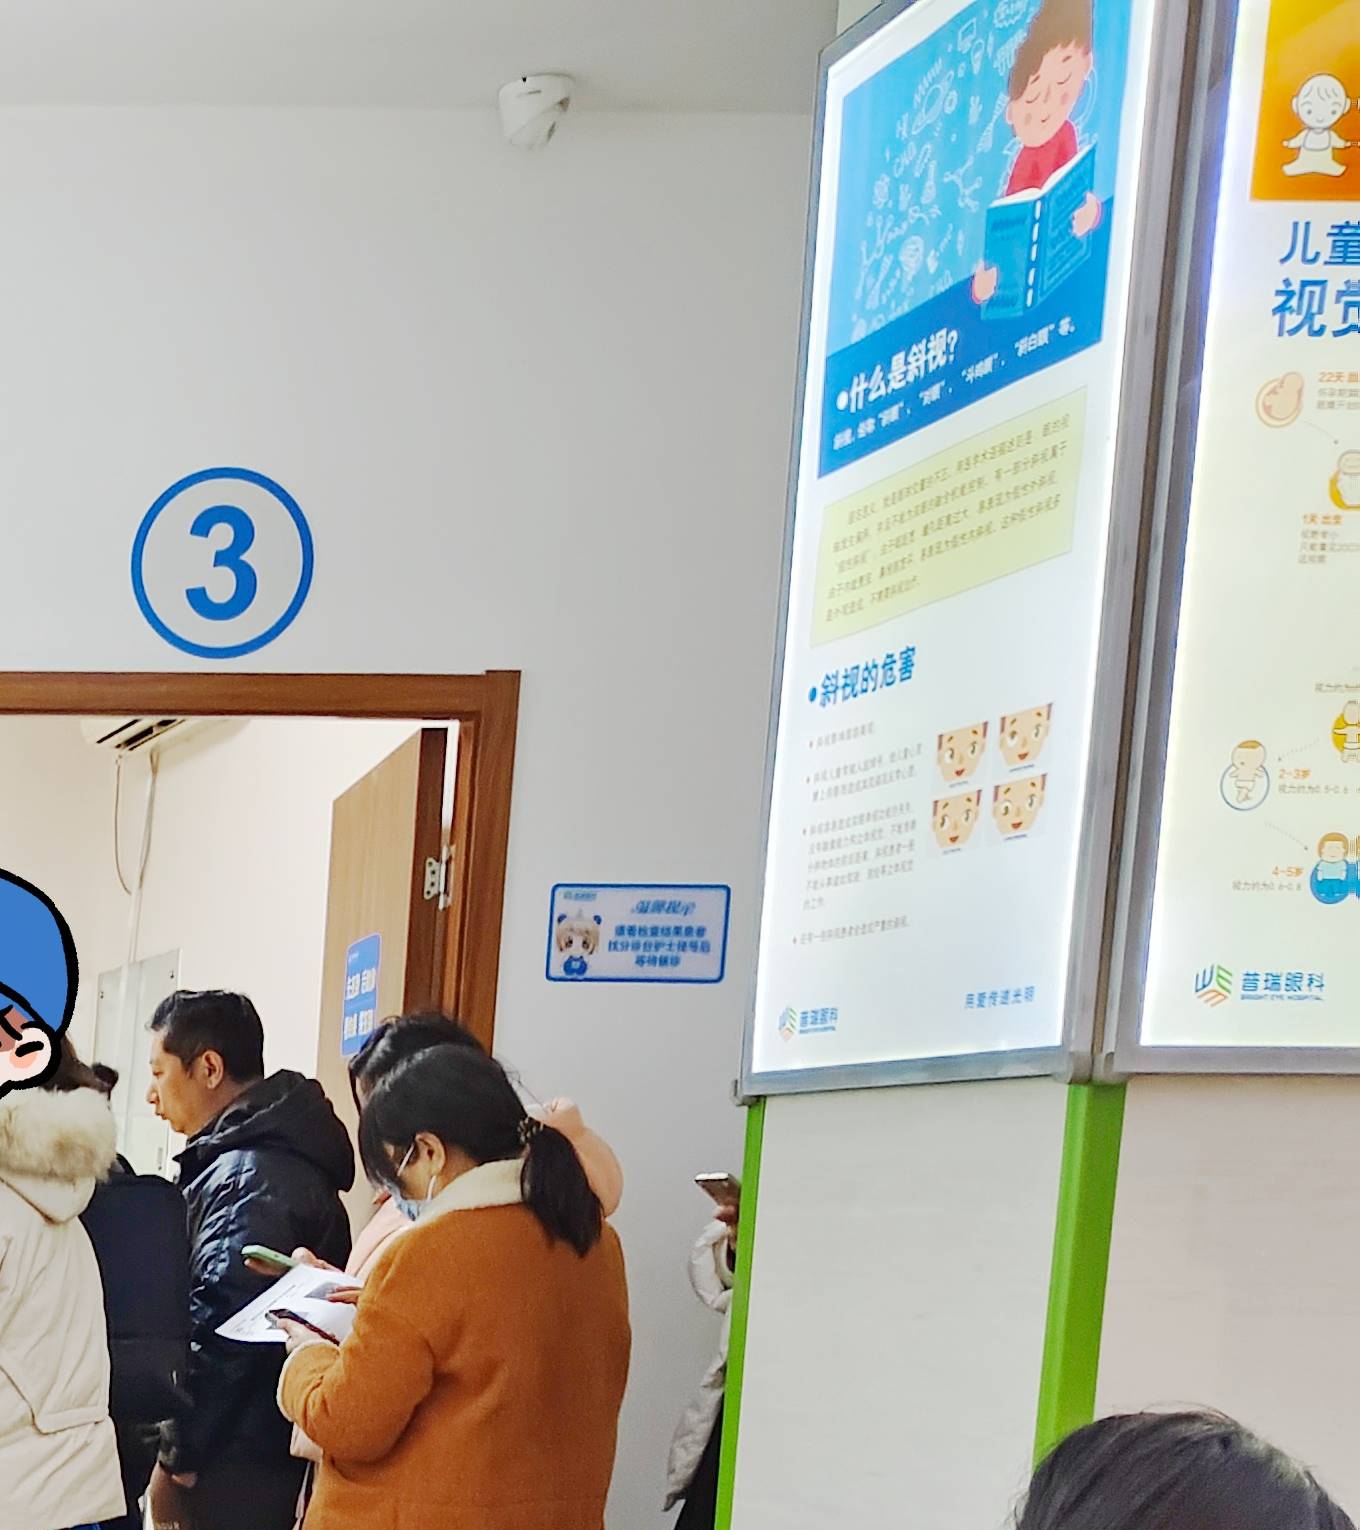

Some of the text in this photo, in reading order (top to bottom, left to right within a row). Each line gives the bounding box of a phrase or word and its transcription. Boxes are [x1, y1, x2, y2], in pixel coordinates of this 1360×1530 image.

[849, 327, 959, 413] 什么是斜视？
[185, 505, 257, 621] 3
[819, 646, 916, 708] 斜视的危害
[1242, 971, 1325, 992] 普瑞眼科
